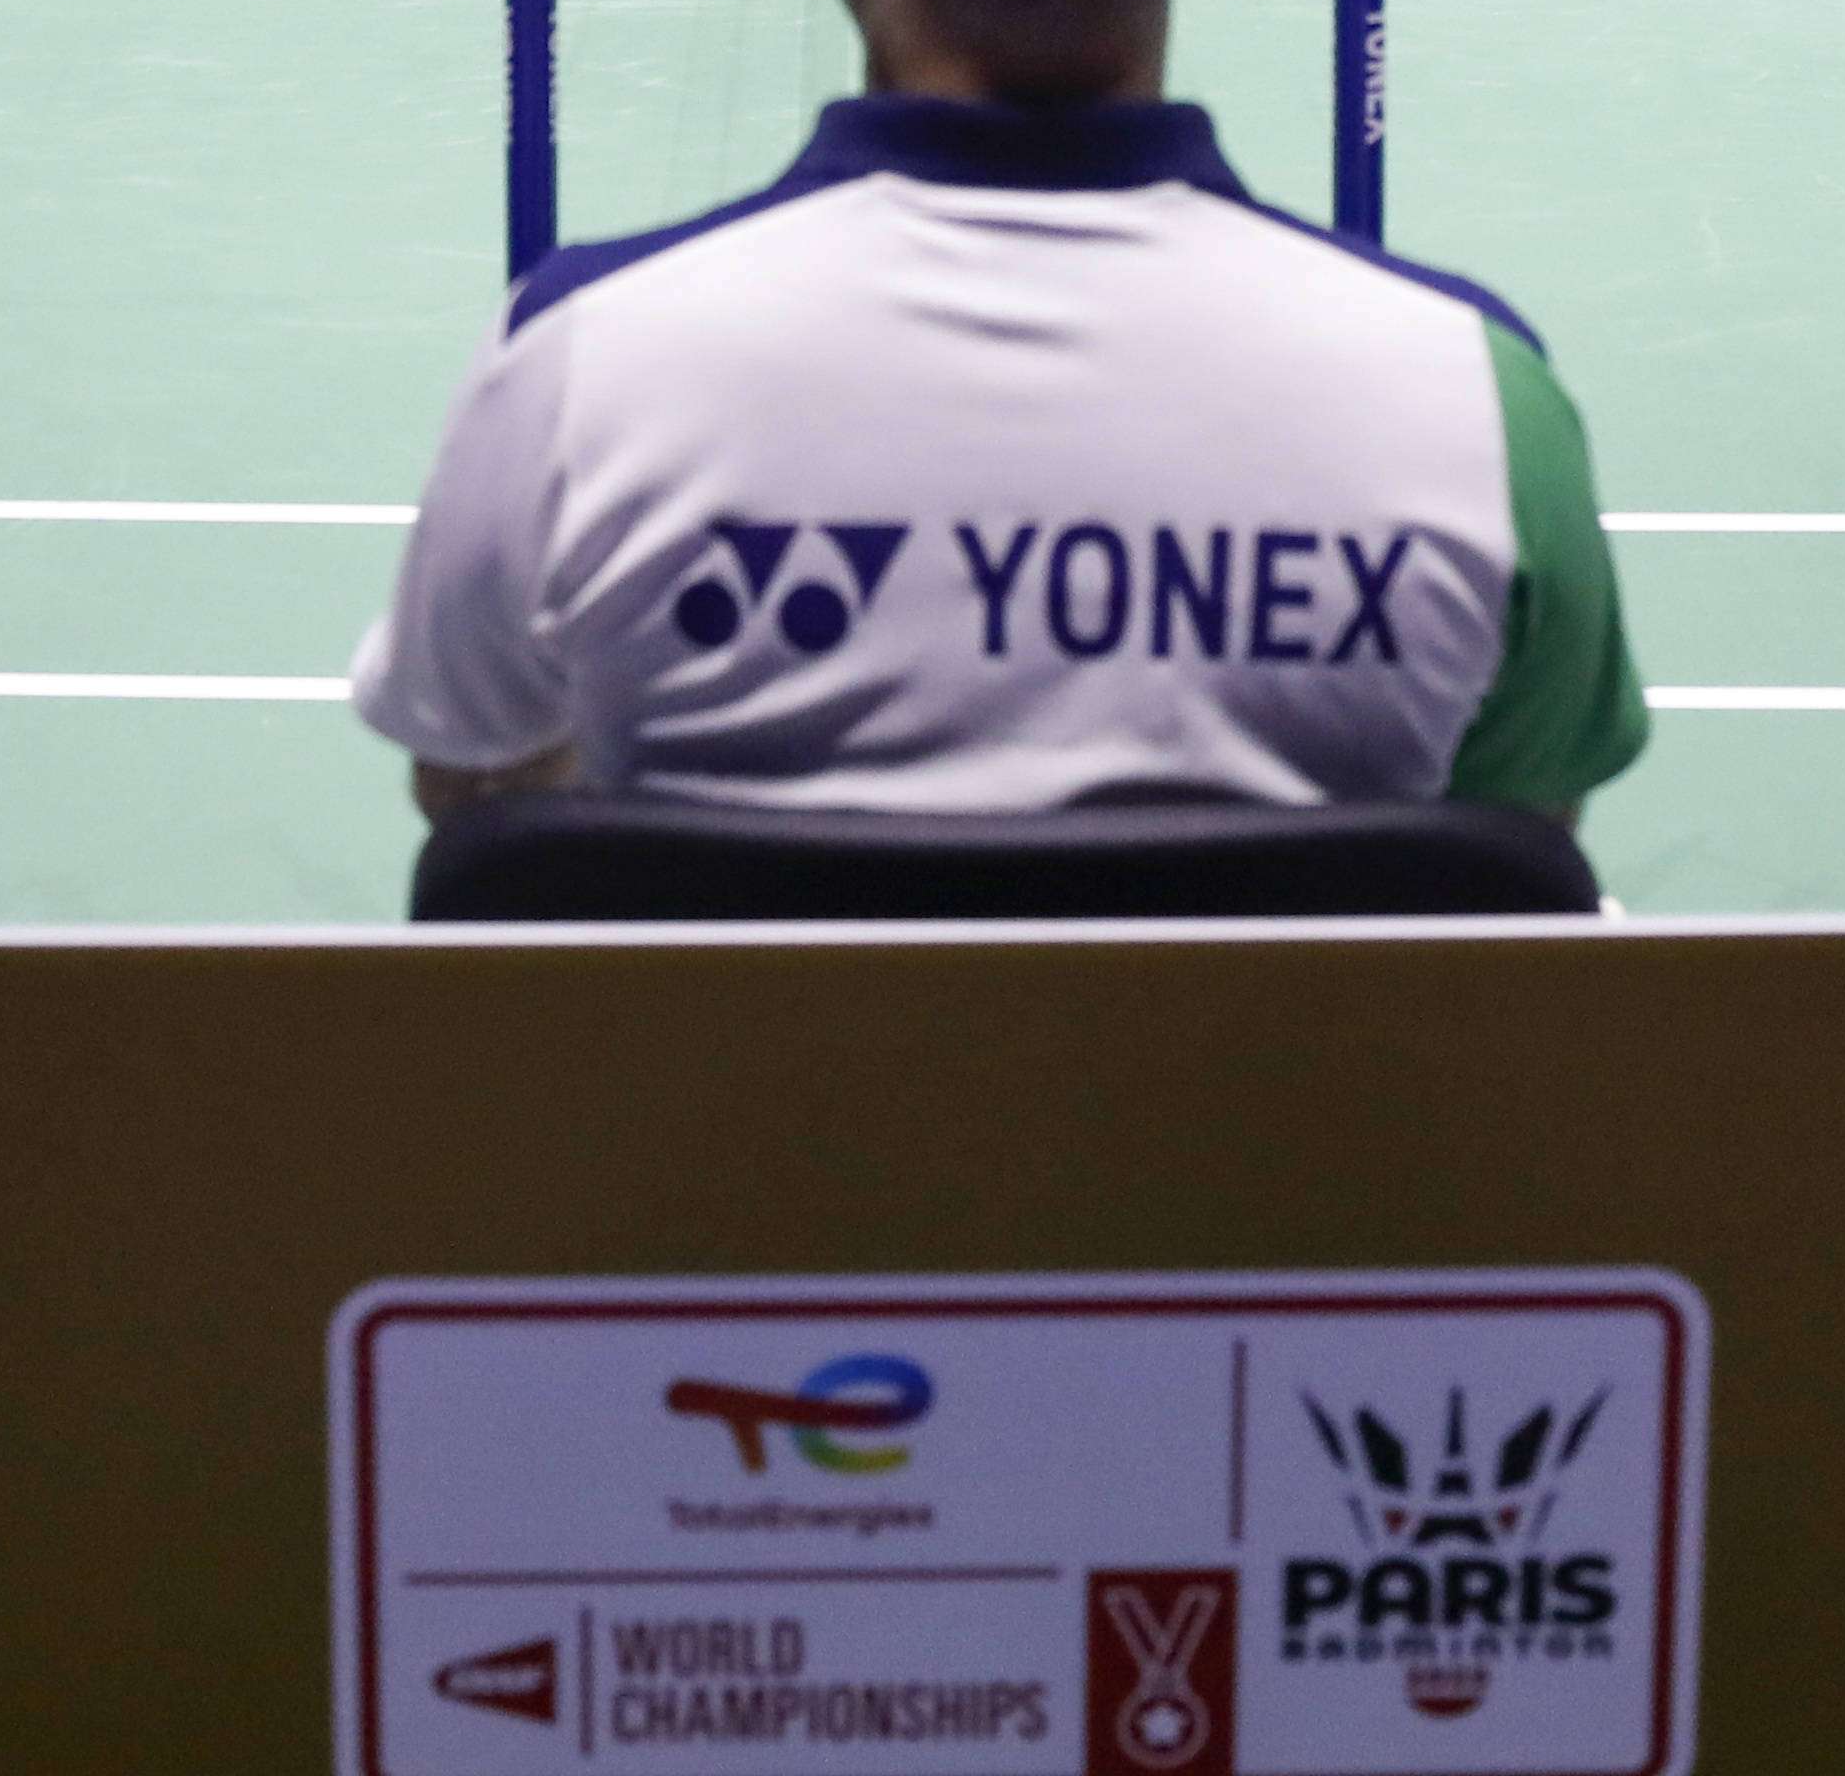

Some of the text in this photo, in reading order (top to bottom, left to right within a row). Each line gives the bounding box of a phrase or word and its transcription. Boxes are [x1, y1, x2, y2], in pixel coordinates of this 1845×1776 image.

[954, 522, 1412, 662] YONEX
[668, 1497, 934, 1538] TotalEnergies
[1284, 1554, 1618, 1627] PARIS
[611, 1617, 806, 1677] WORLD
[610, 1681, 1051, 1746] CHAMPIONSHIPS
